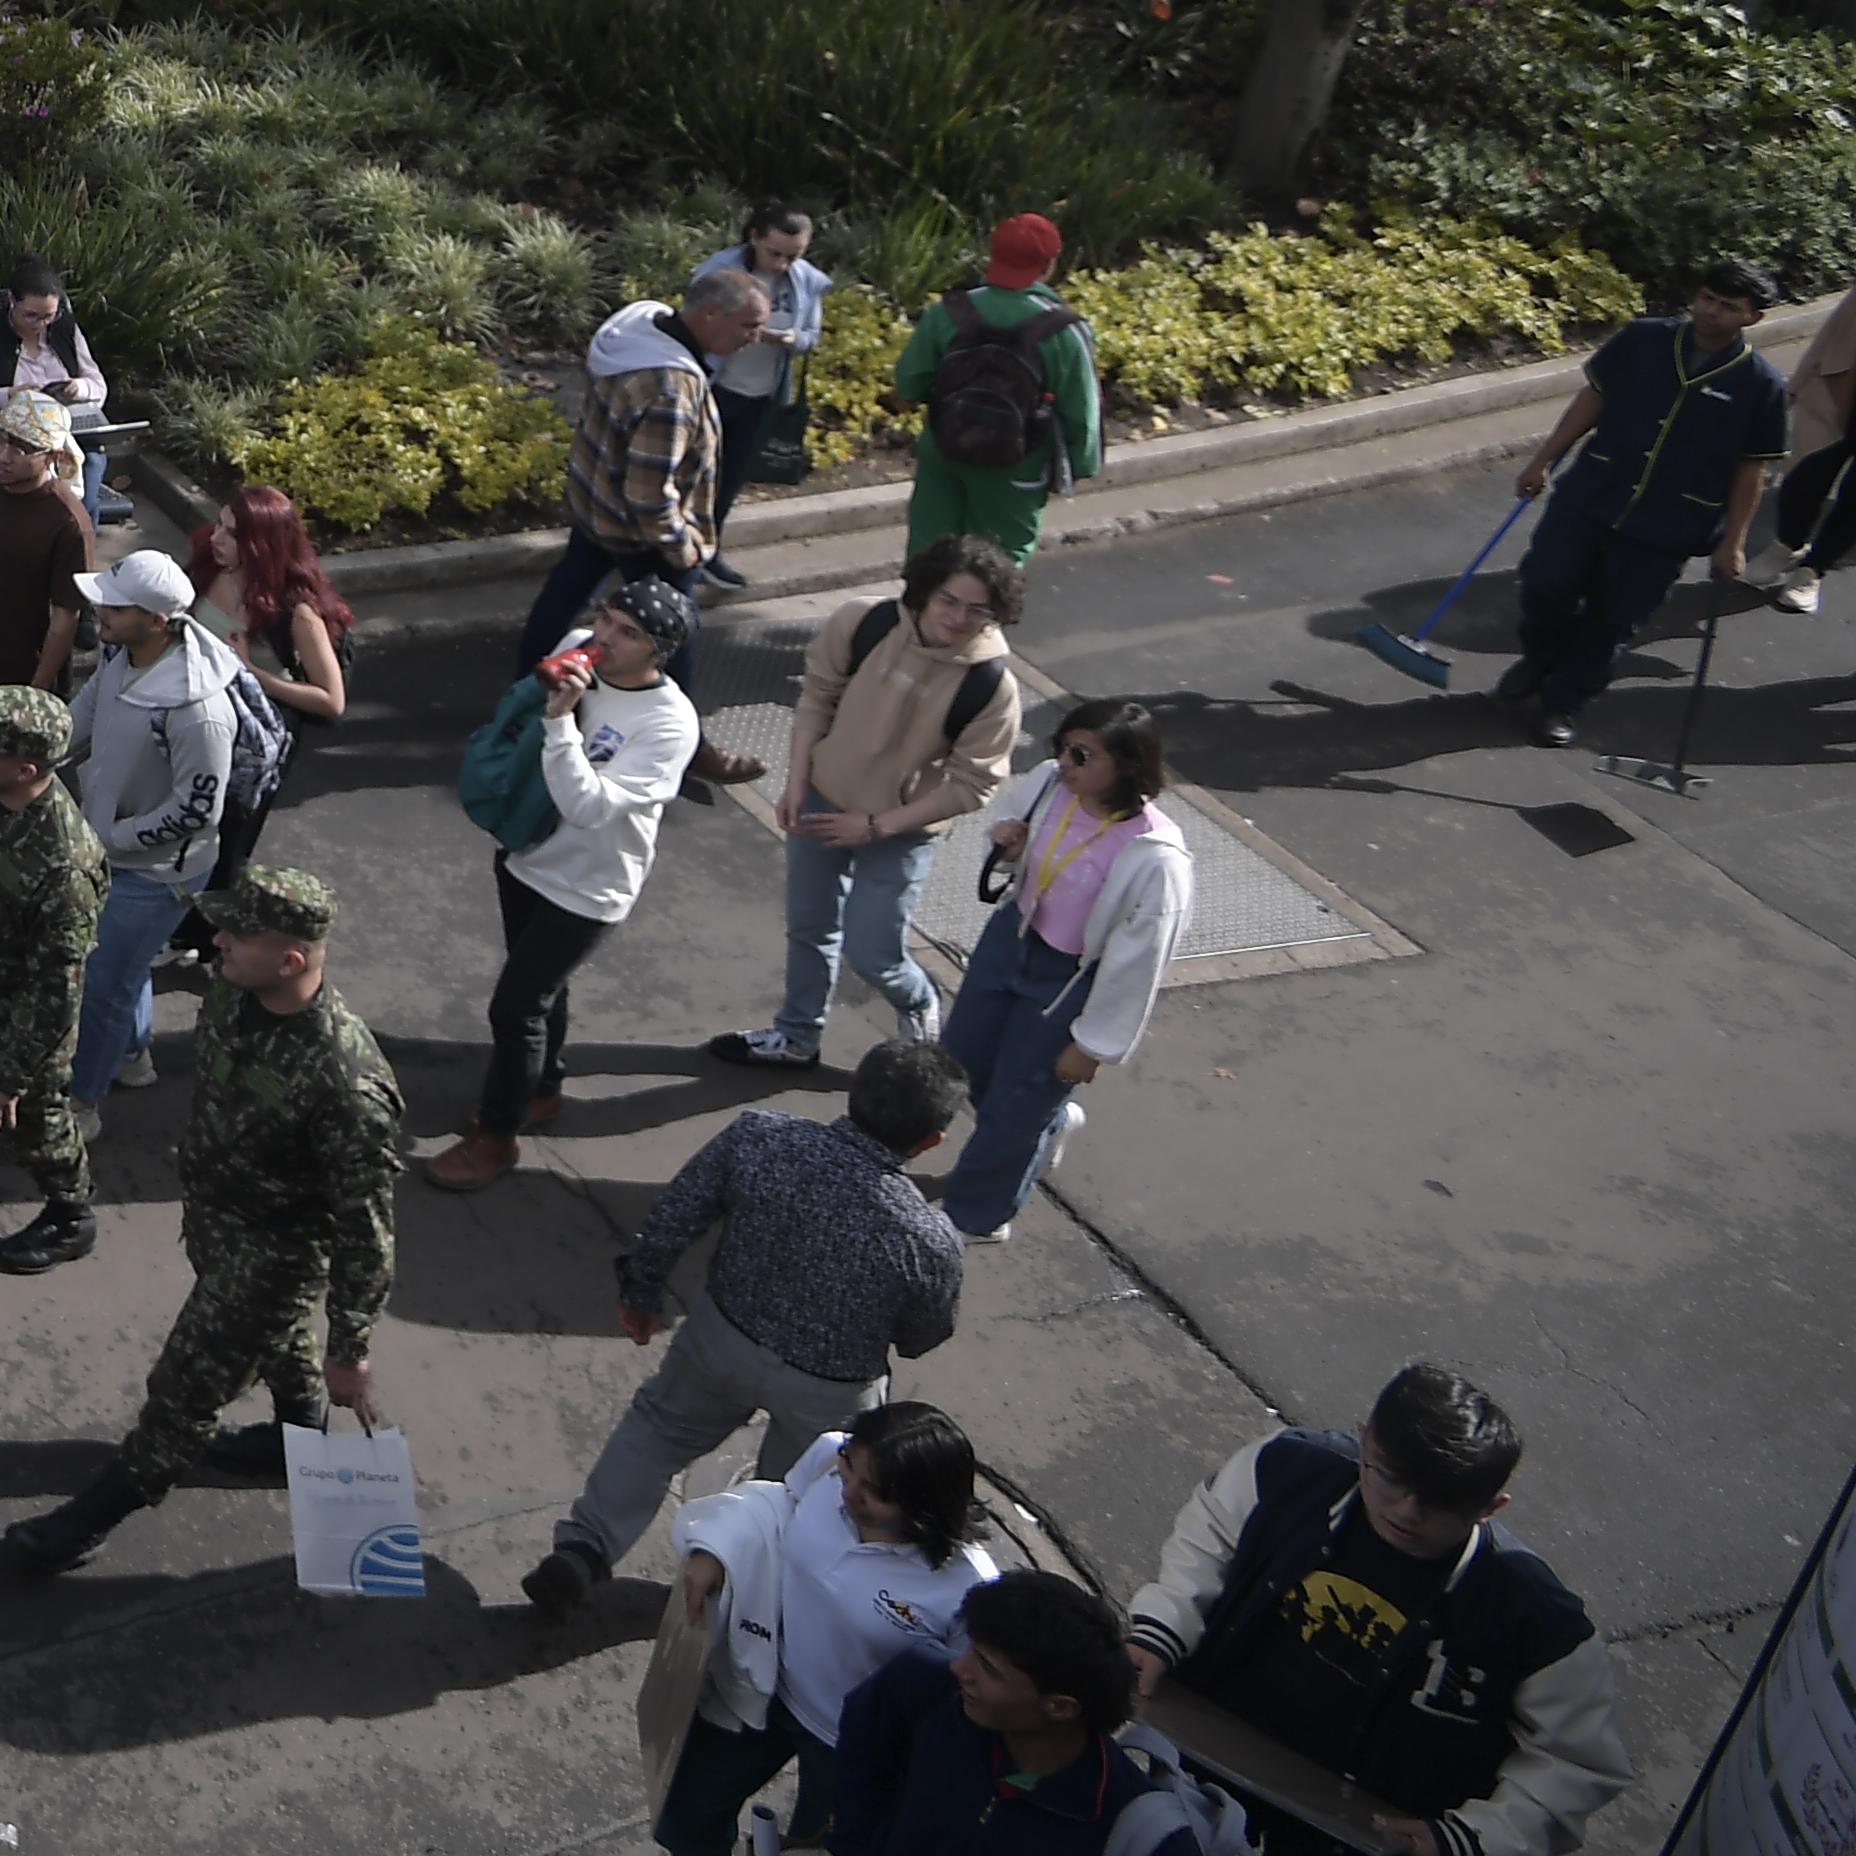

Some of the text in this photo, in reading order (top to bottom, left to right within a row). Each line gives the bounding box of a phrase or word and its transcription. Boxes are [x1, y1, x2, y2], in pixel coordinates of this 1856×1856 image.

[137, 773, 219, 846] adidas
[299, 1466, 399, 1483] Grupo Planeta
